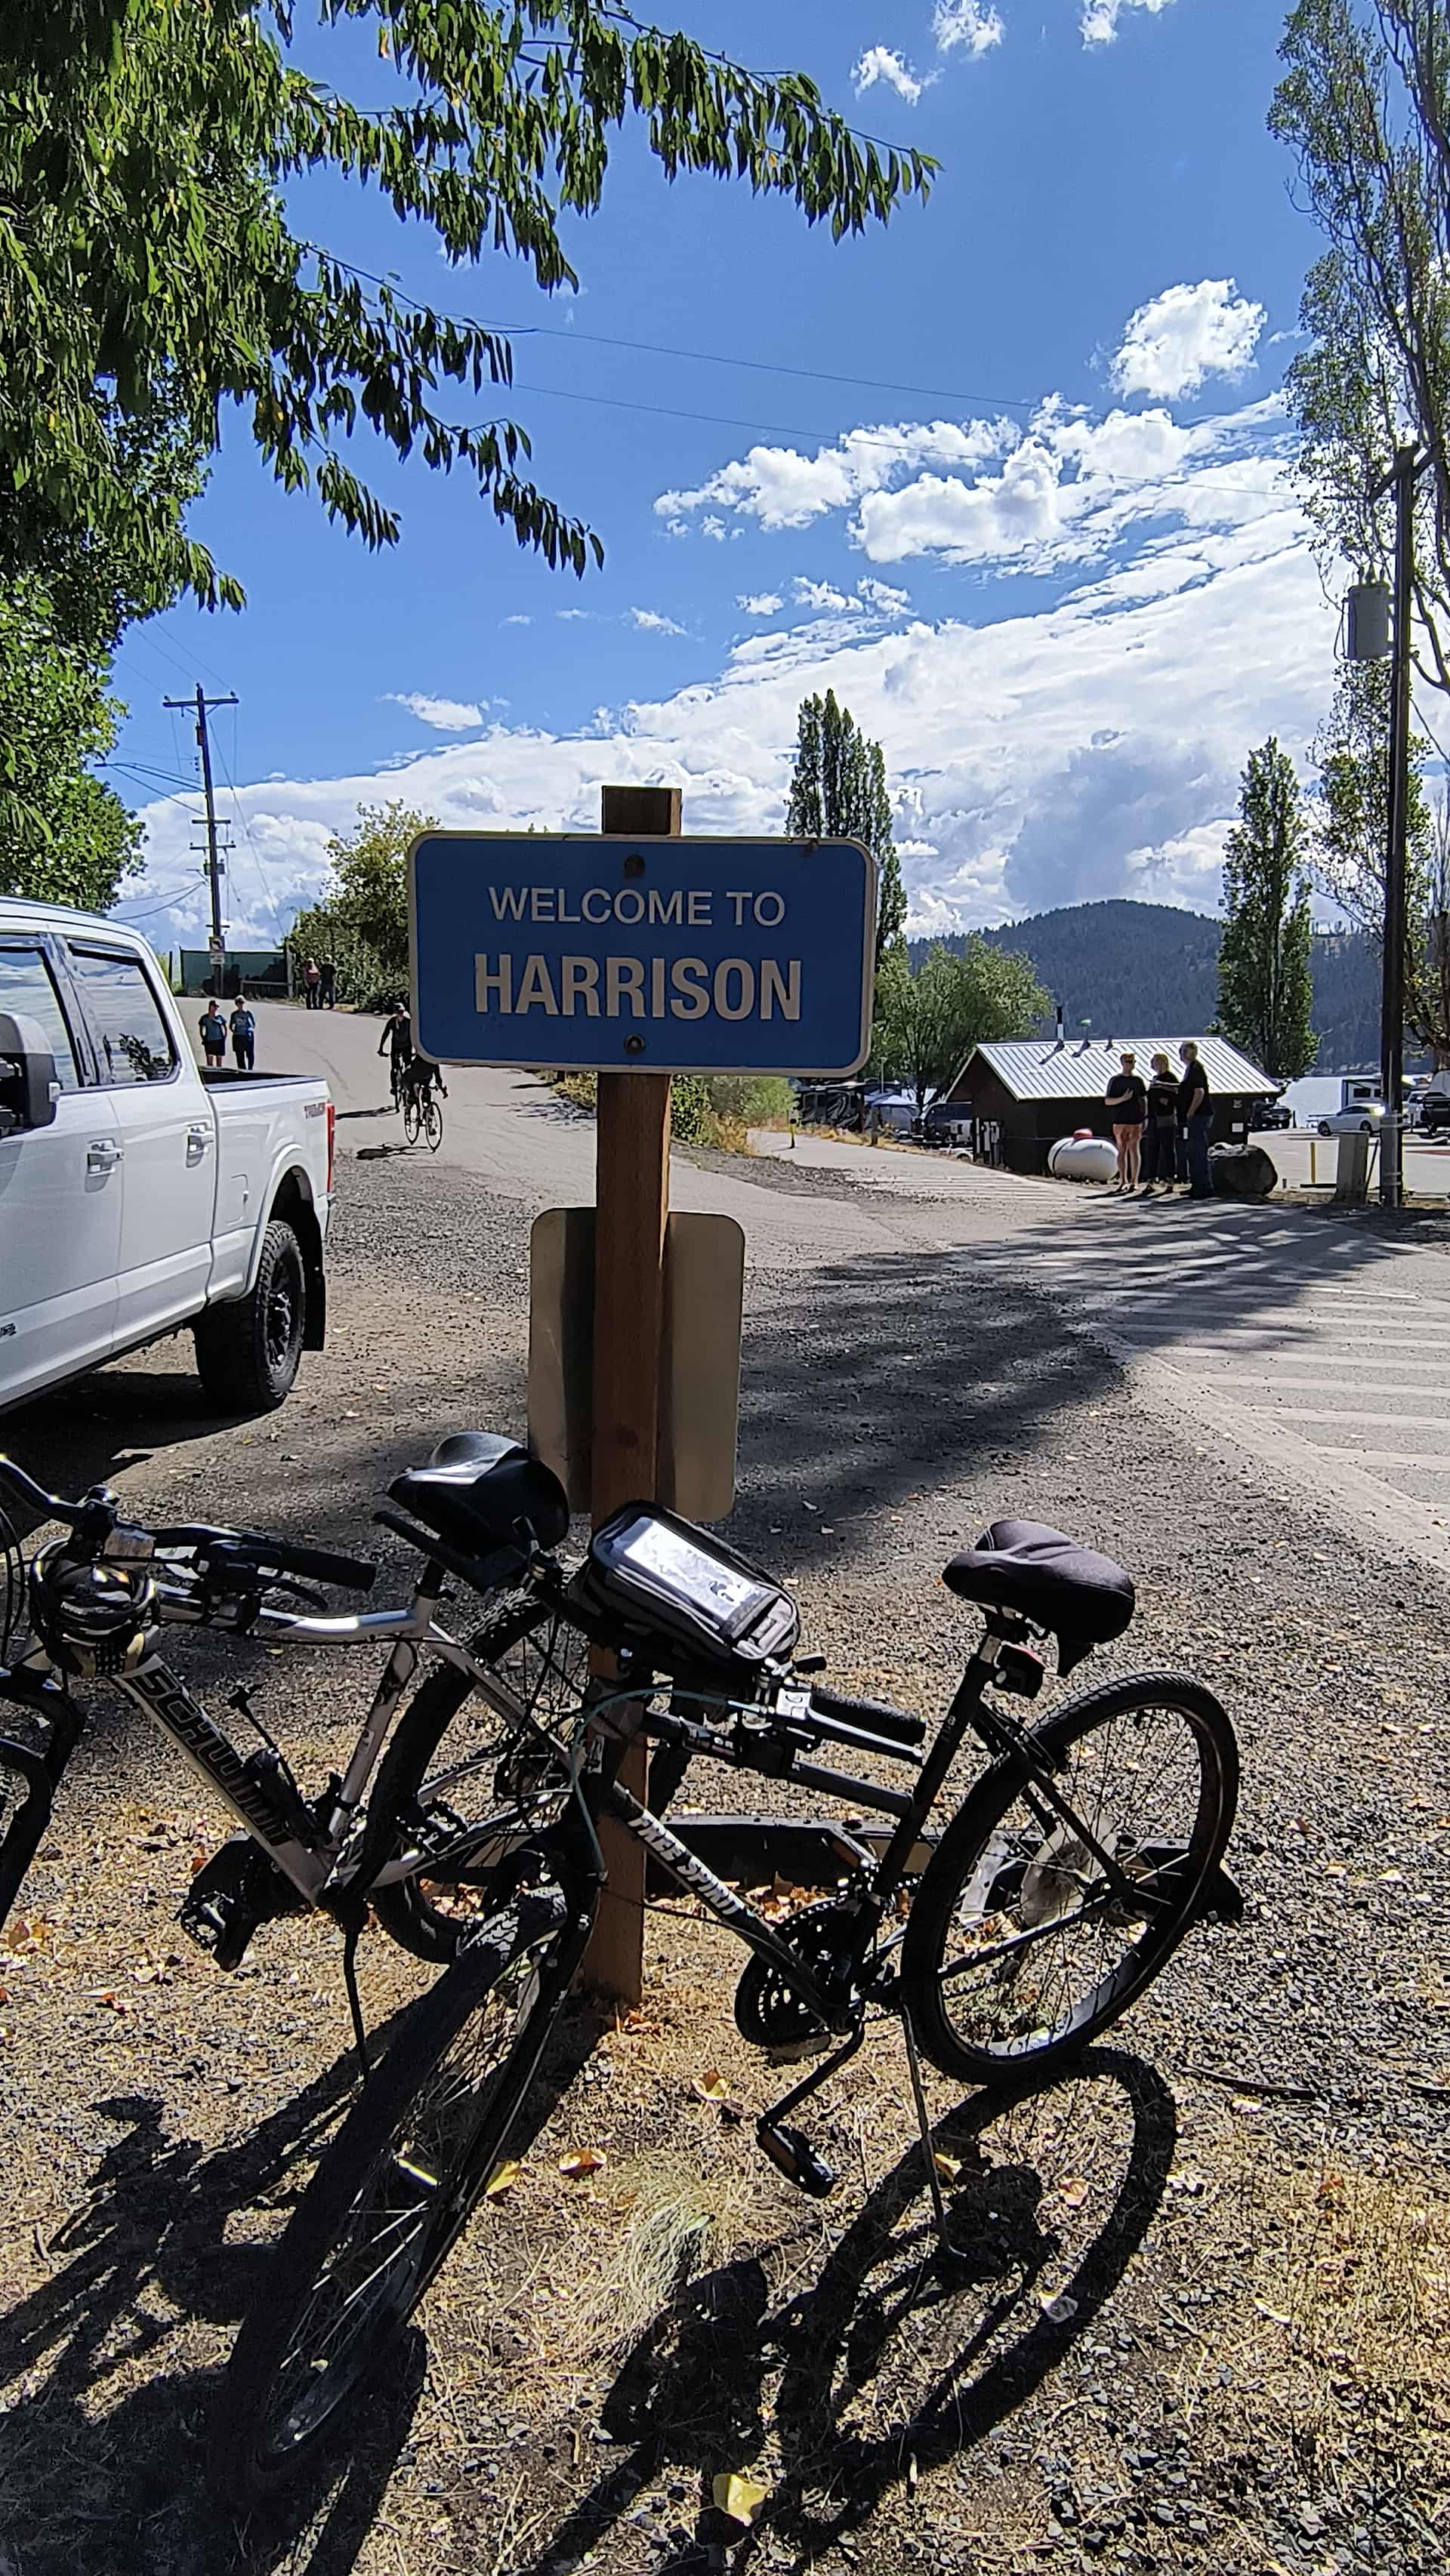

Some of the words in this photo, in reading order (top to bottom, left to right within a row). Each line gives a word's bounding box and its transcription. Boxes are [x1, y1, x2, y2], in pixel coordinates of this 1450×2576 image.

[488, 886, 713, 926] WELCOME
[726, 891, 785, 927] TO
[474, 953, 802, 1021] HARRISON
[628, 1810, 688, 1861] FREE
[677, 1855, 746, 1915] SPIRIT
